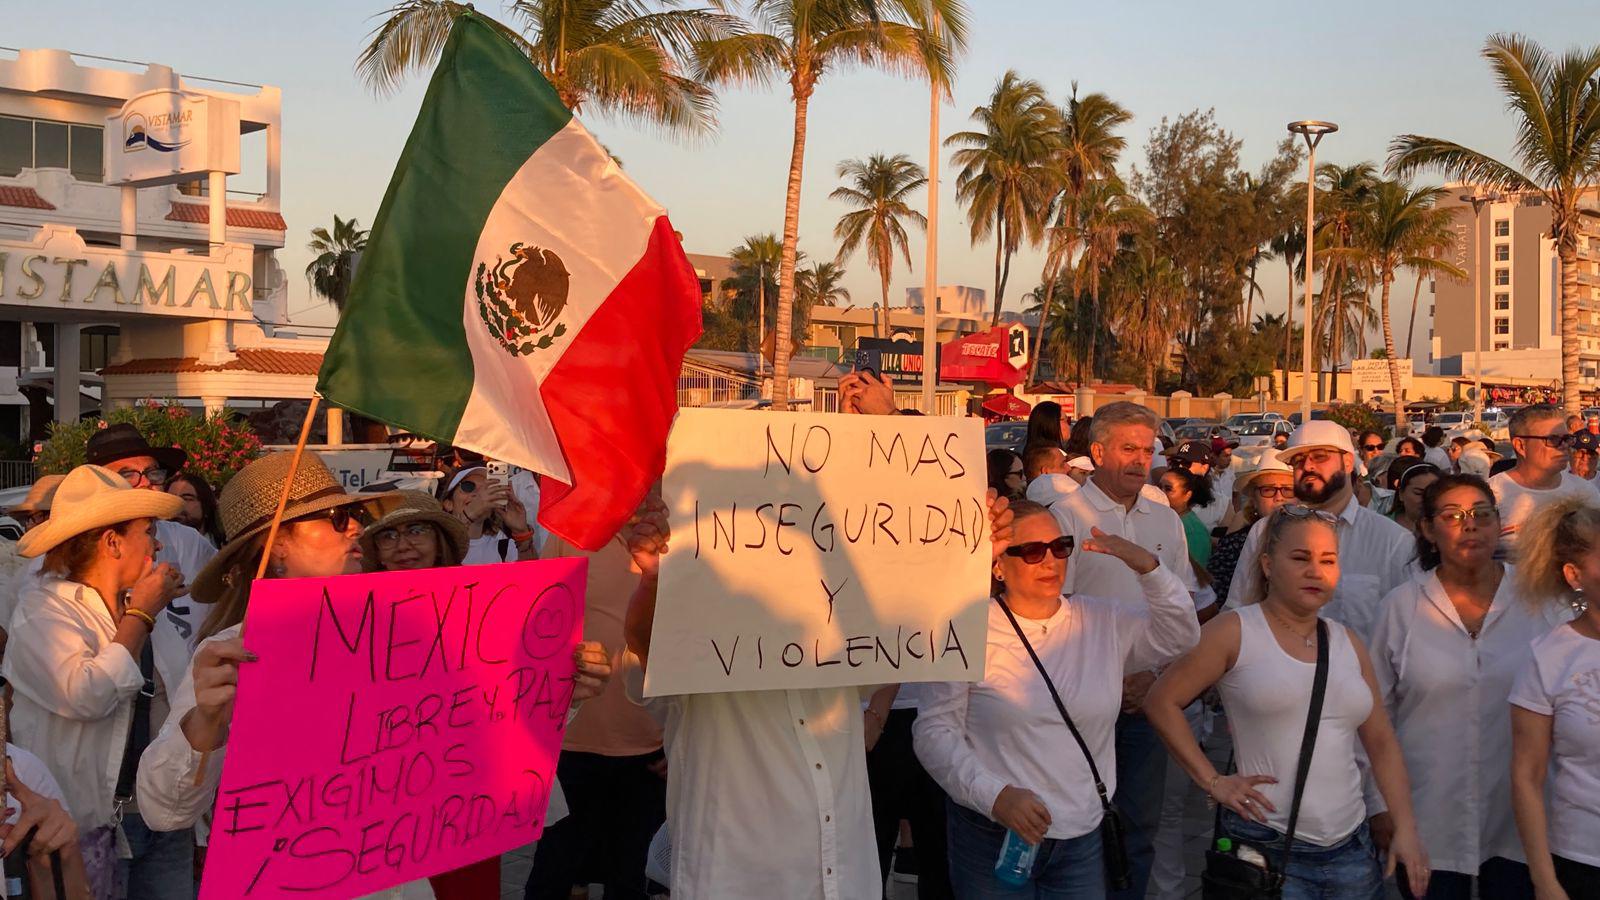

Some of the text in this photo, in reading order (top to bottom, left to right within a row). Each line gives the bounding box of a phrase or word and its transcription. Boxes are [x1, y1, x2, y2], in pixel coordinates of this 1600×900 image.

[148, 110, 193, 127] VISTAMAR
[1455, 224, 1467, 266] VARALI
[902, 354, 923, 372] UNIO
[339, 468, 370, 488] Tel.
[763, 423, 965, 480] NO MAS
[694, 496, 984, 560] INSEGURIDAD
[820, 576, 849, 625] Y
[711, 618, 969, 677] VIOLENCIA
[340, 684, 479, 766] LIBRE
[223, 743, 475, 837] EXIGIMOS
